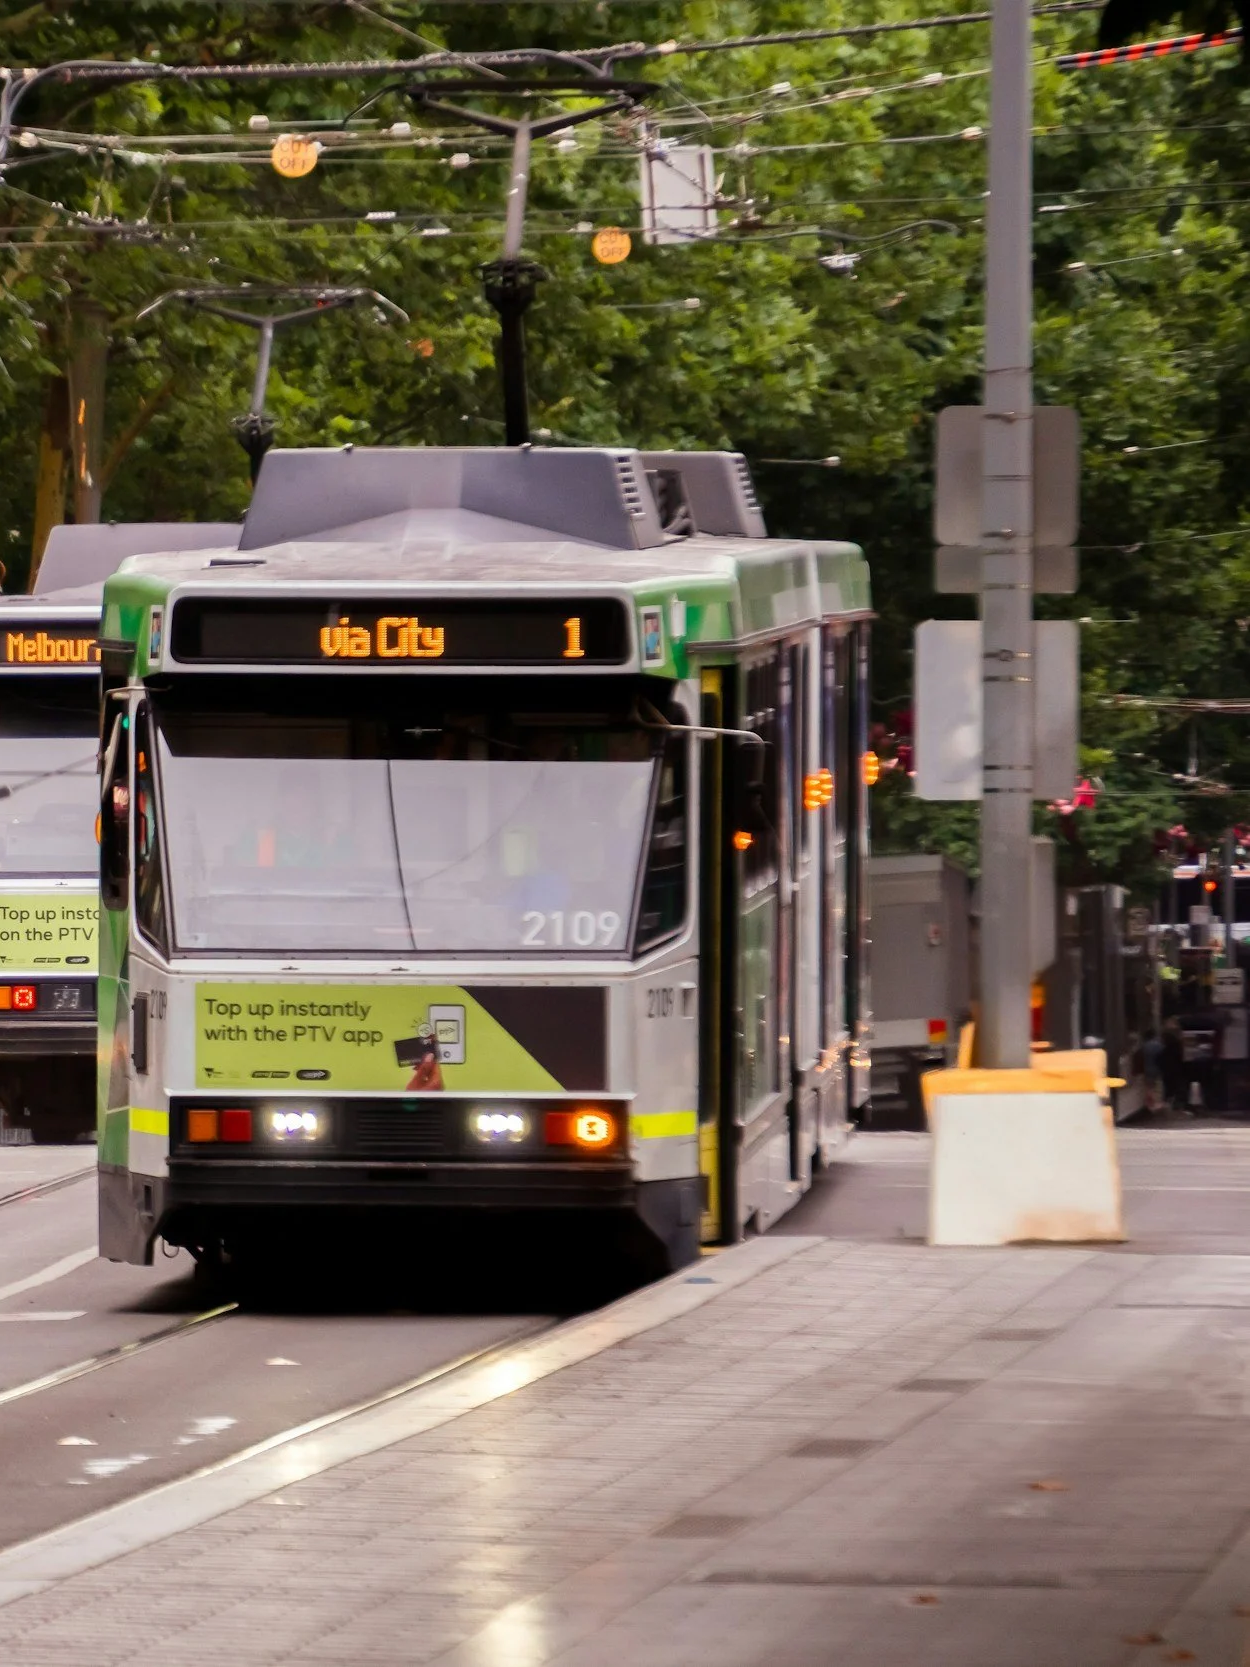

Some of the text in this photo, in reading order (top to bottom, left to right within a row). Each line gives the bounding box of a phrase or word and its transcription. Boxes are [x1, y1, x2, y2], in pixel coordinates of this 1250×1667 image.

[320, 617, 444, 657] via City
[562, 617, 585, 657] 1
[35, 910, 56, 923] up
[0, 927, 94, 941] on the PTV
[522, 911, 621, 946] 2109
[204, 998, 372, 1021] Top up instantly
[204, 1025, 384, 1047] with the PTV app
